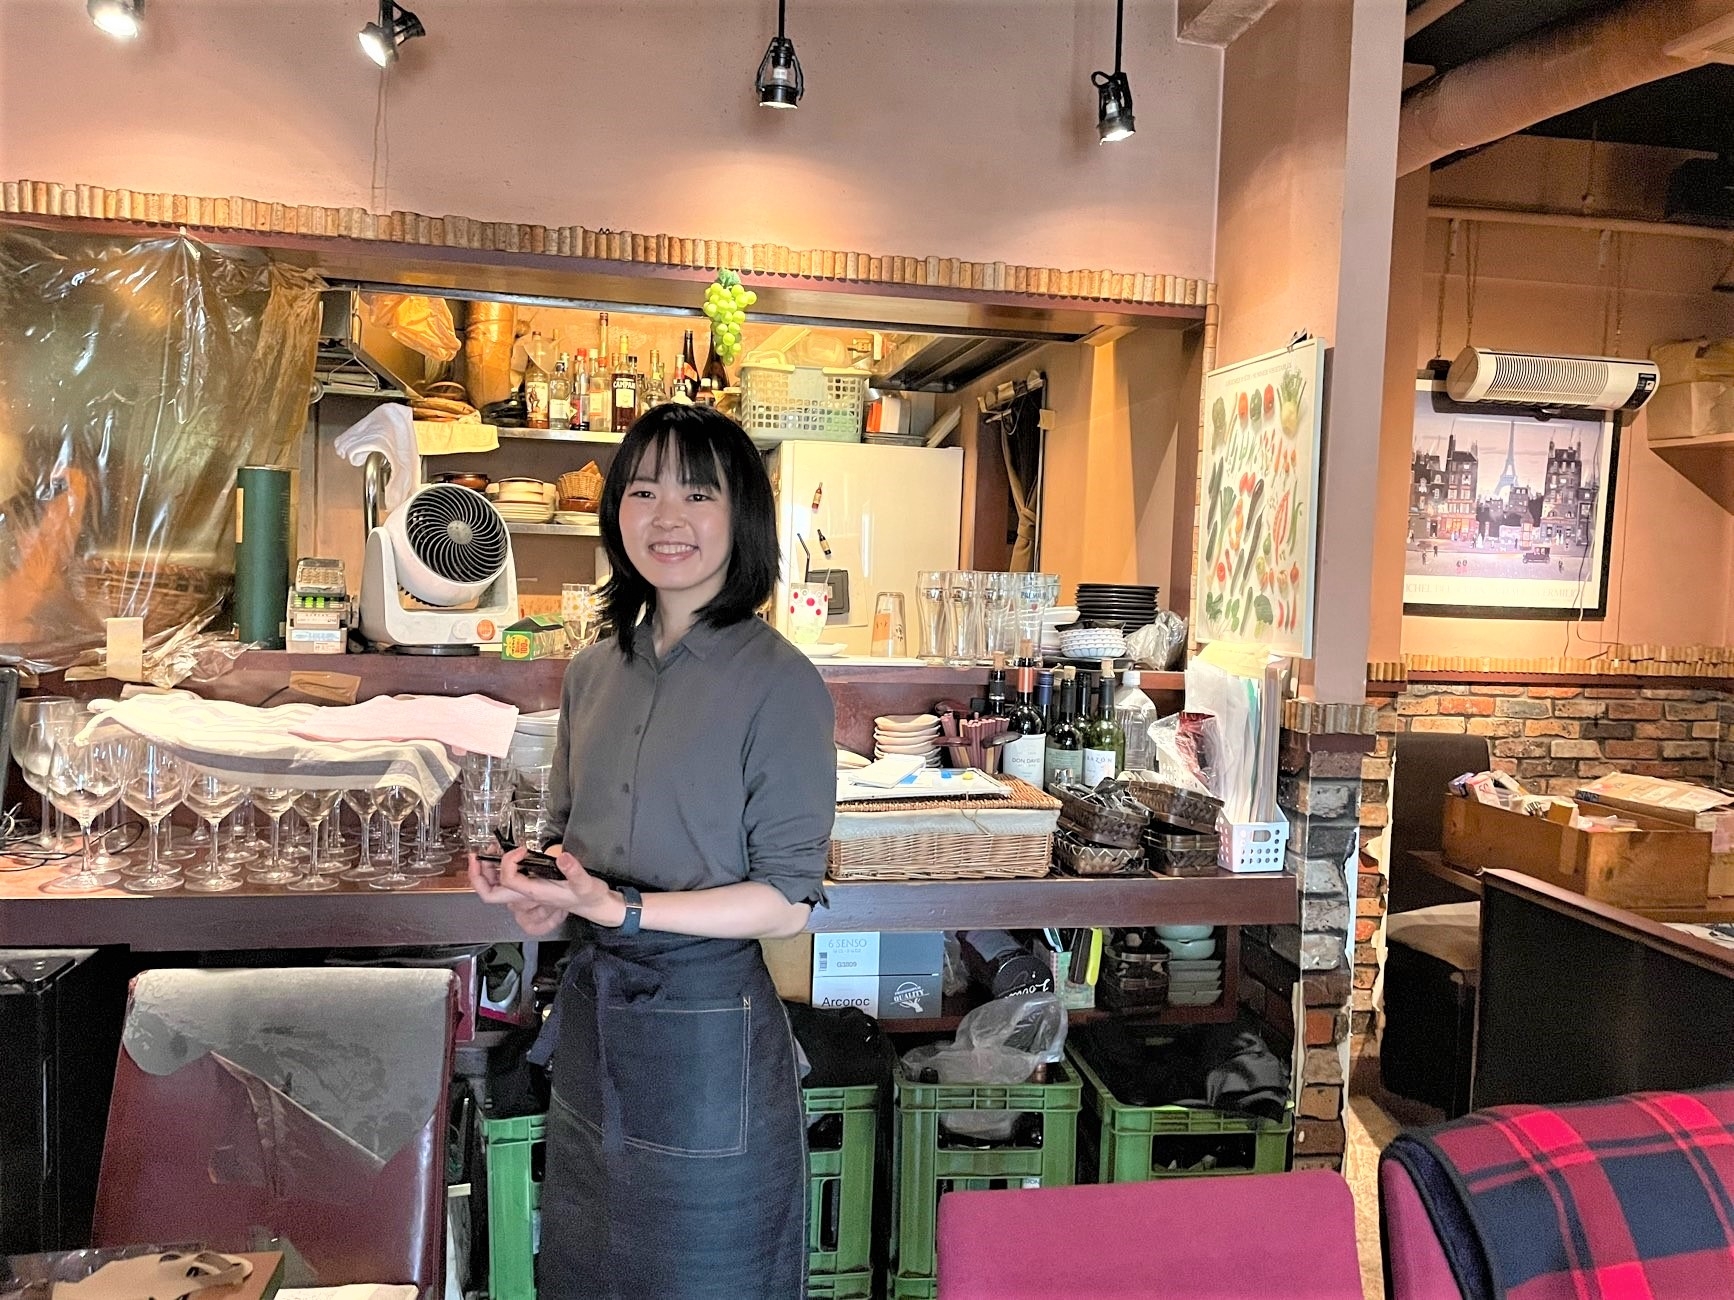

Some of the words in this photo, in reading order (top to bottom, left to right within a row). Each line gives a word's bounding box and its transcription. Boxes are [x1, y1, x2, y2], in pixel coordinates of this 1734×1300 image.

[835, 938, 867, 948] SENSO
[821, 996, 870, 1007] Arcoroc
[893, 990, 924, 1002] QUALITY
